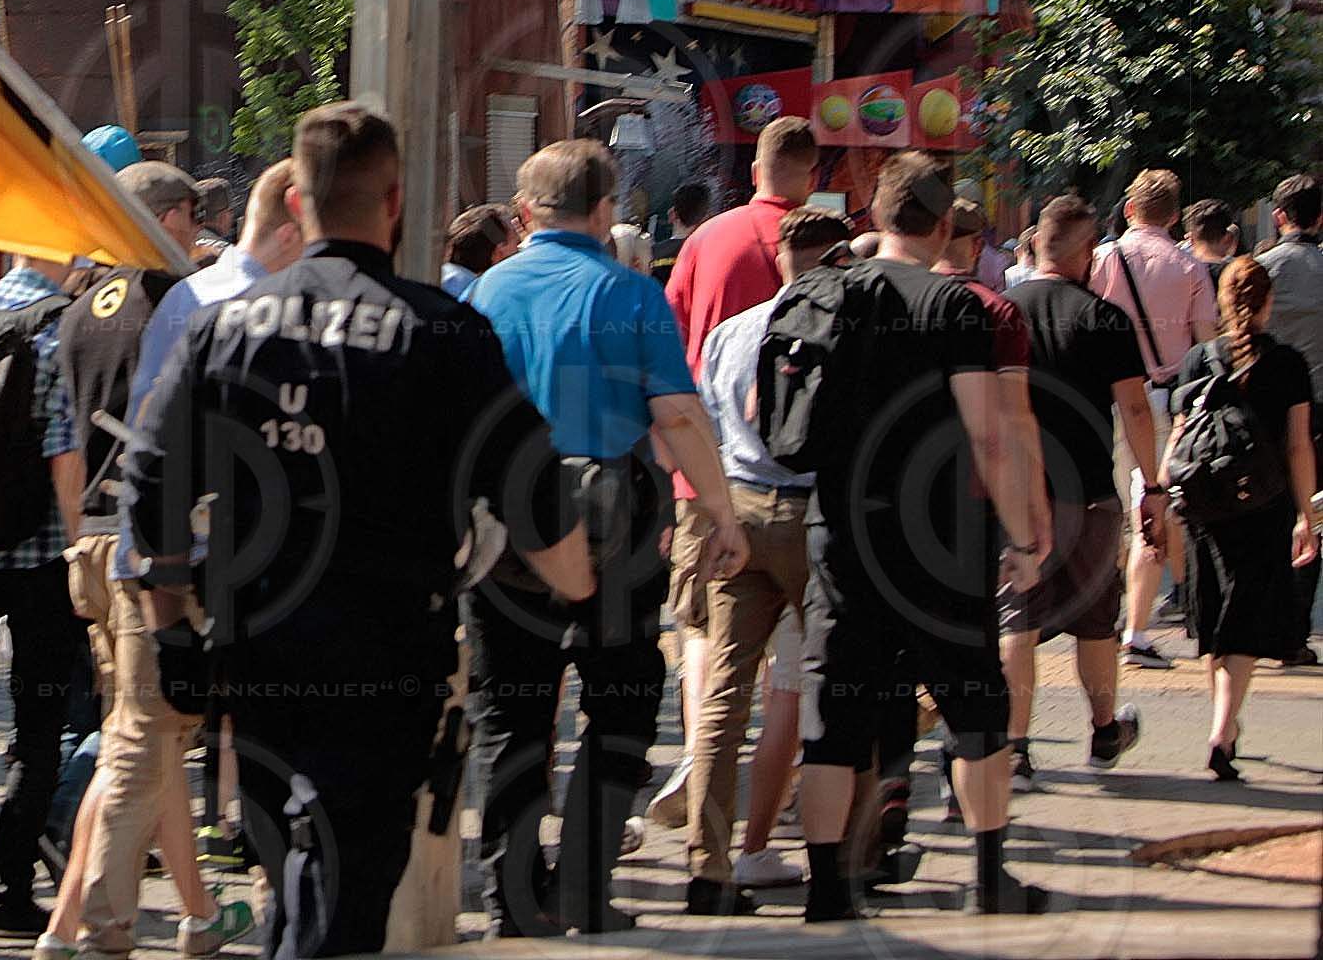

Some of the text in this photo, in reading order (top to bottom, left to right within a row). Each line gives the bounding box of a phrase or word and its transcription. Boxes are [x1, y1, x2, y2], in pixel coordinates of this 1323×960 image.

[214, 294, 406, 353] POLIZEI
[279, 382, 309, 415] U
[260, 419, 325, 455] 130
